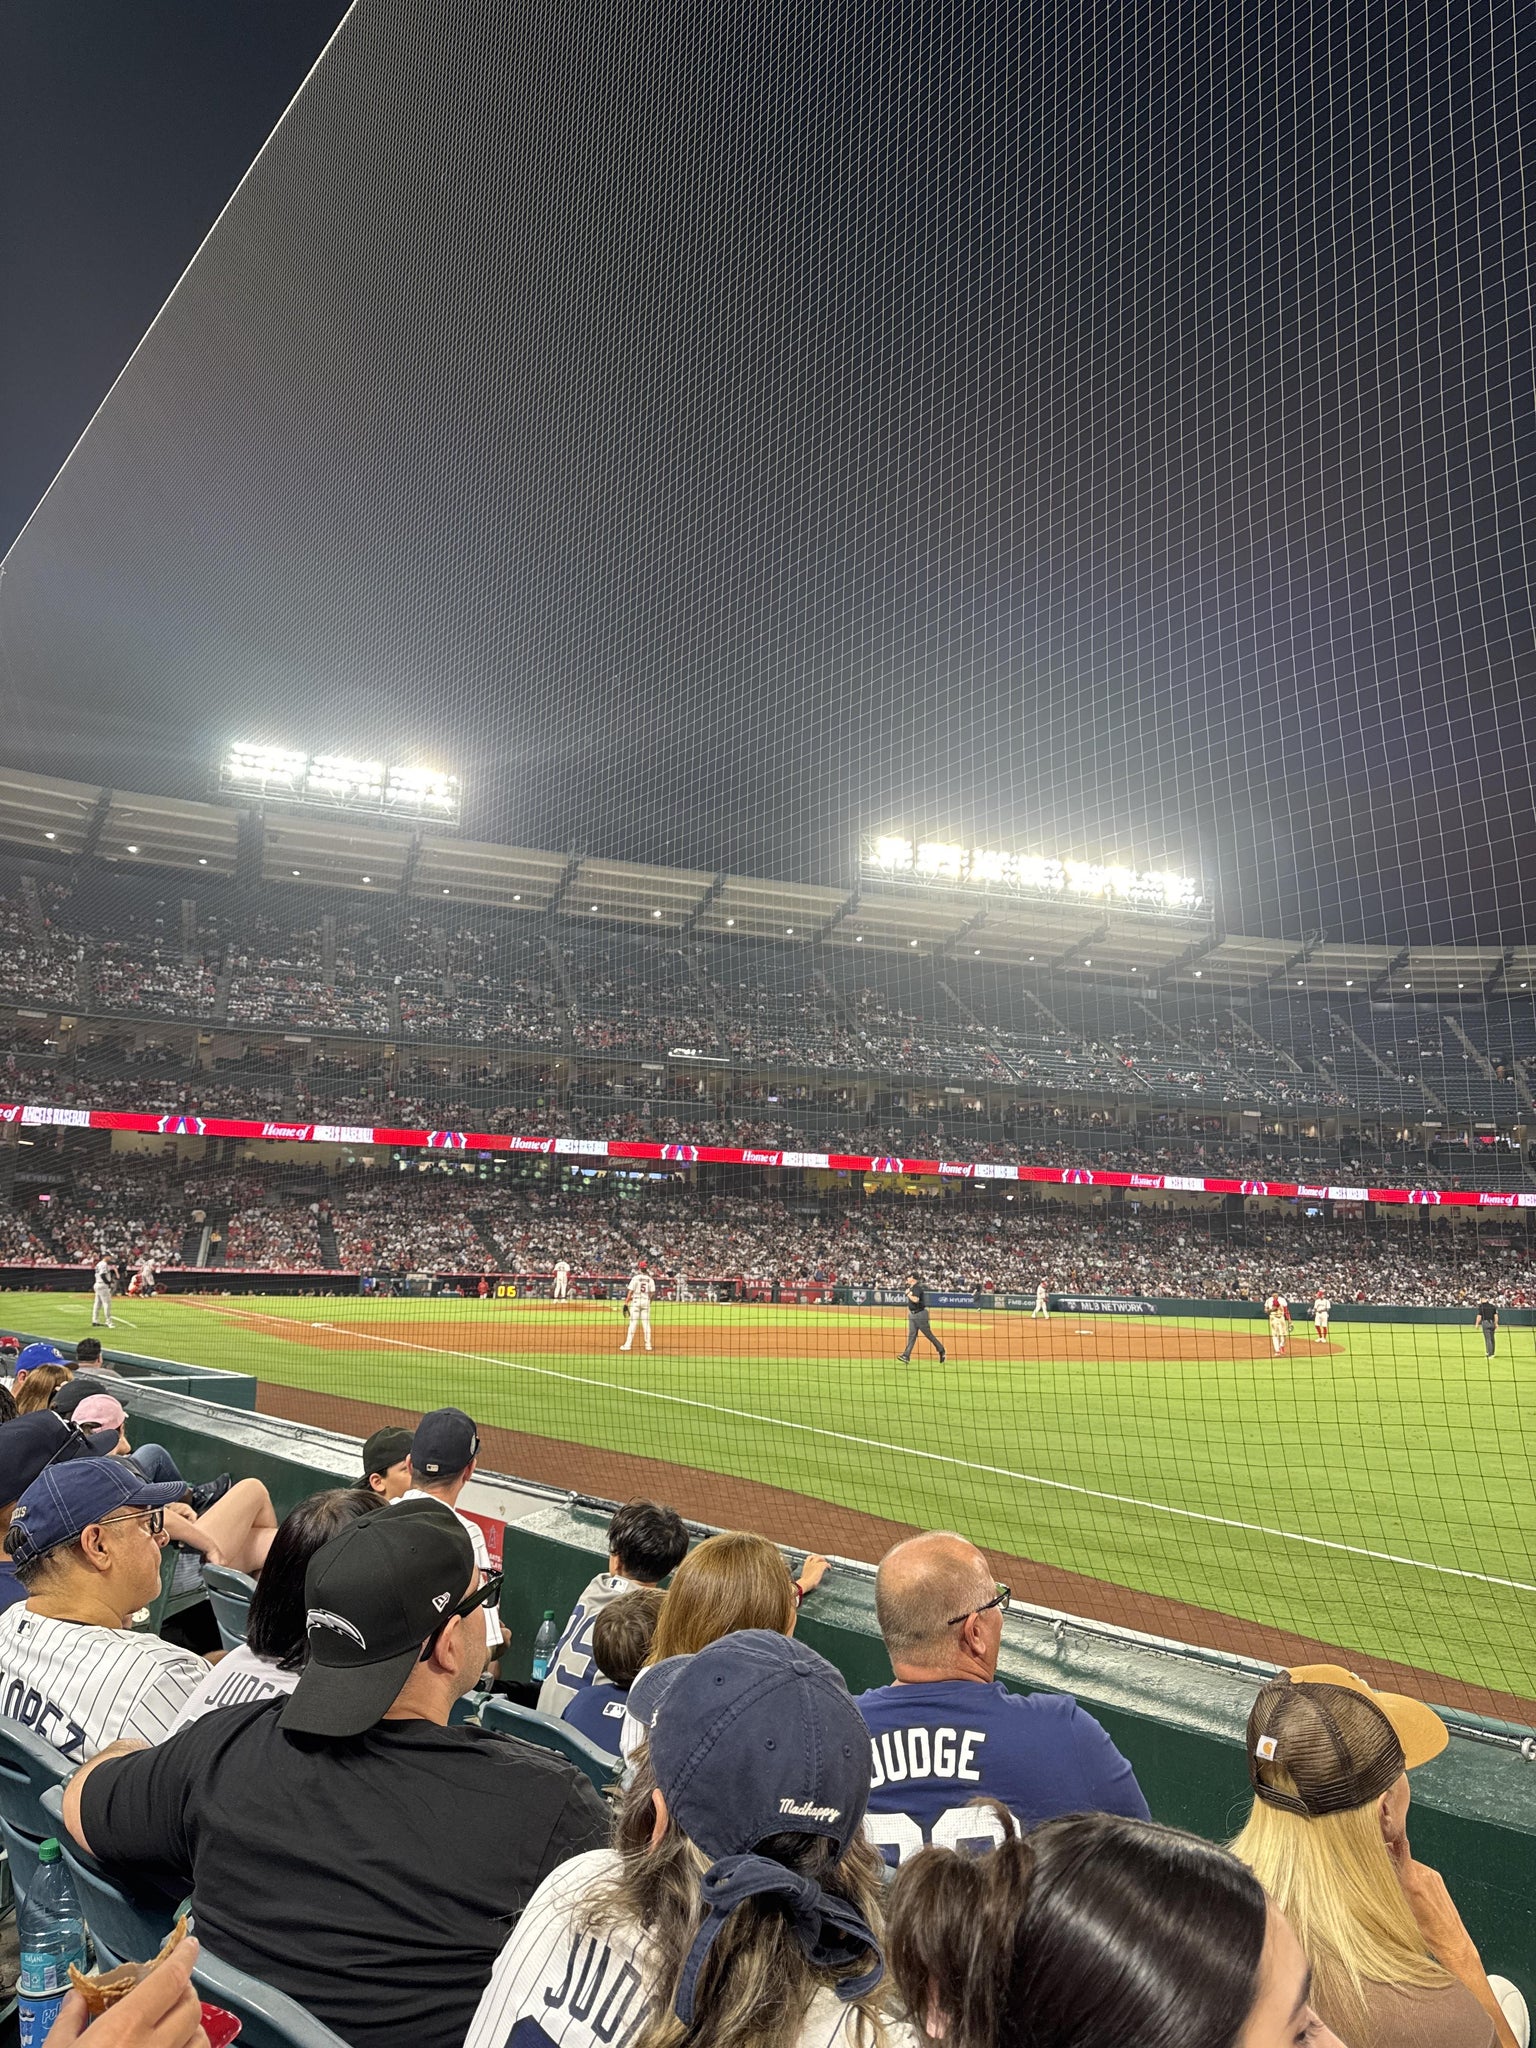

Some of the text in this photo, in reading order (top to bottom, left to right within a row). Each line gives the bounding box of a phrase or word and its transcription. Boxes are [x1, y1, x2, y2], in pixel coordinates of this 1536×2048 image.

[261, 1123, 296, 1137] Home
[296, 1125, 311, 1140] of
[510, 1136, 540, 1149] Home
[540, 1139, 553, 1153] of
[742, 1150, 769, 1162] Home
[769, 1151, 780, 1166] of
[938, 1163, 963, 1174] Home
[962, 1164, 973, 1177] of
[1130, 1174, 1153, 1186] Home
[1480, 1193, 1505, 1205] Home
[640, 1283, 647, 1293] 5
[1081, 1302, 1144, 1313] MLB NETWORK
[204, 1671, 288, 1707] JUDG
[0, 1671, 87, 1756] OPEZ
[779, 1798, 841, 1823] Madhappy
